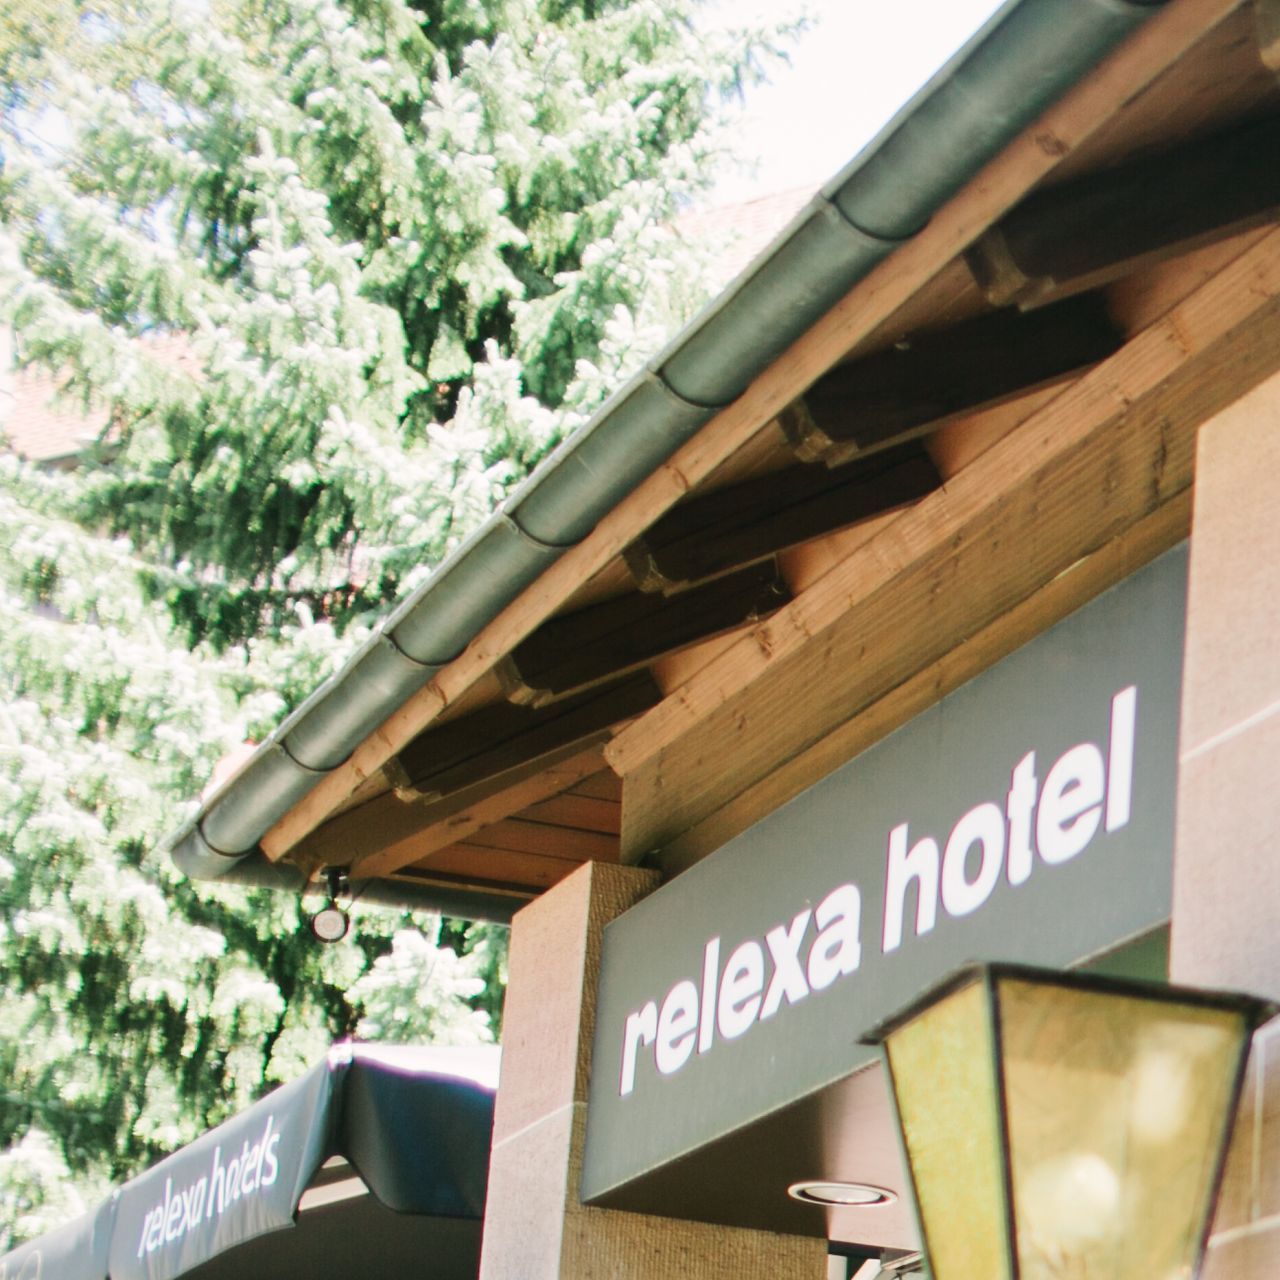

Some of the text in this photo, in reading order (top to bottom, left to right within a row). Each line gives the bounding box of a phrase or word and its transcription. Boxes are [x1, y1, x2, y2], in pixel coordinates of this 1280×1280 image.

[619, 685, 1137, 1097] relexa hotel
[136, 1114, 281, 1258] relexa hotels
